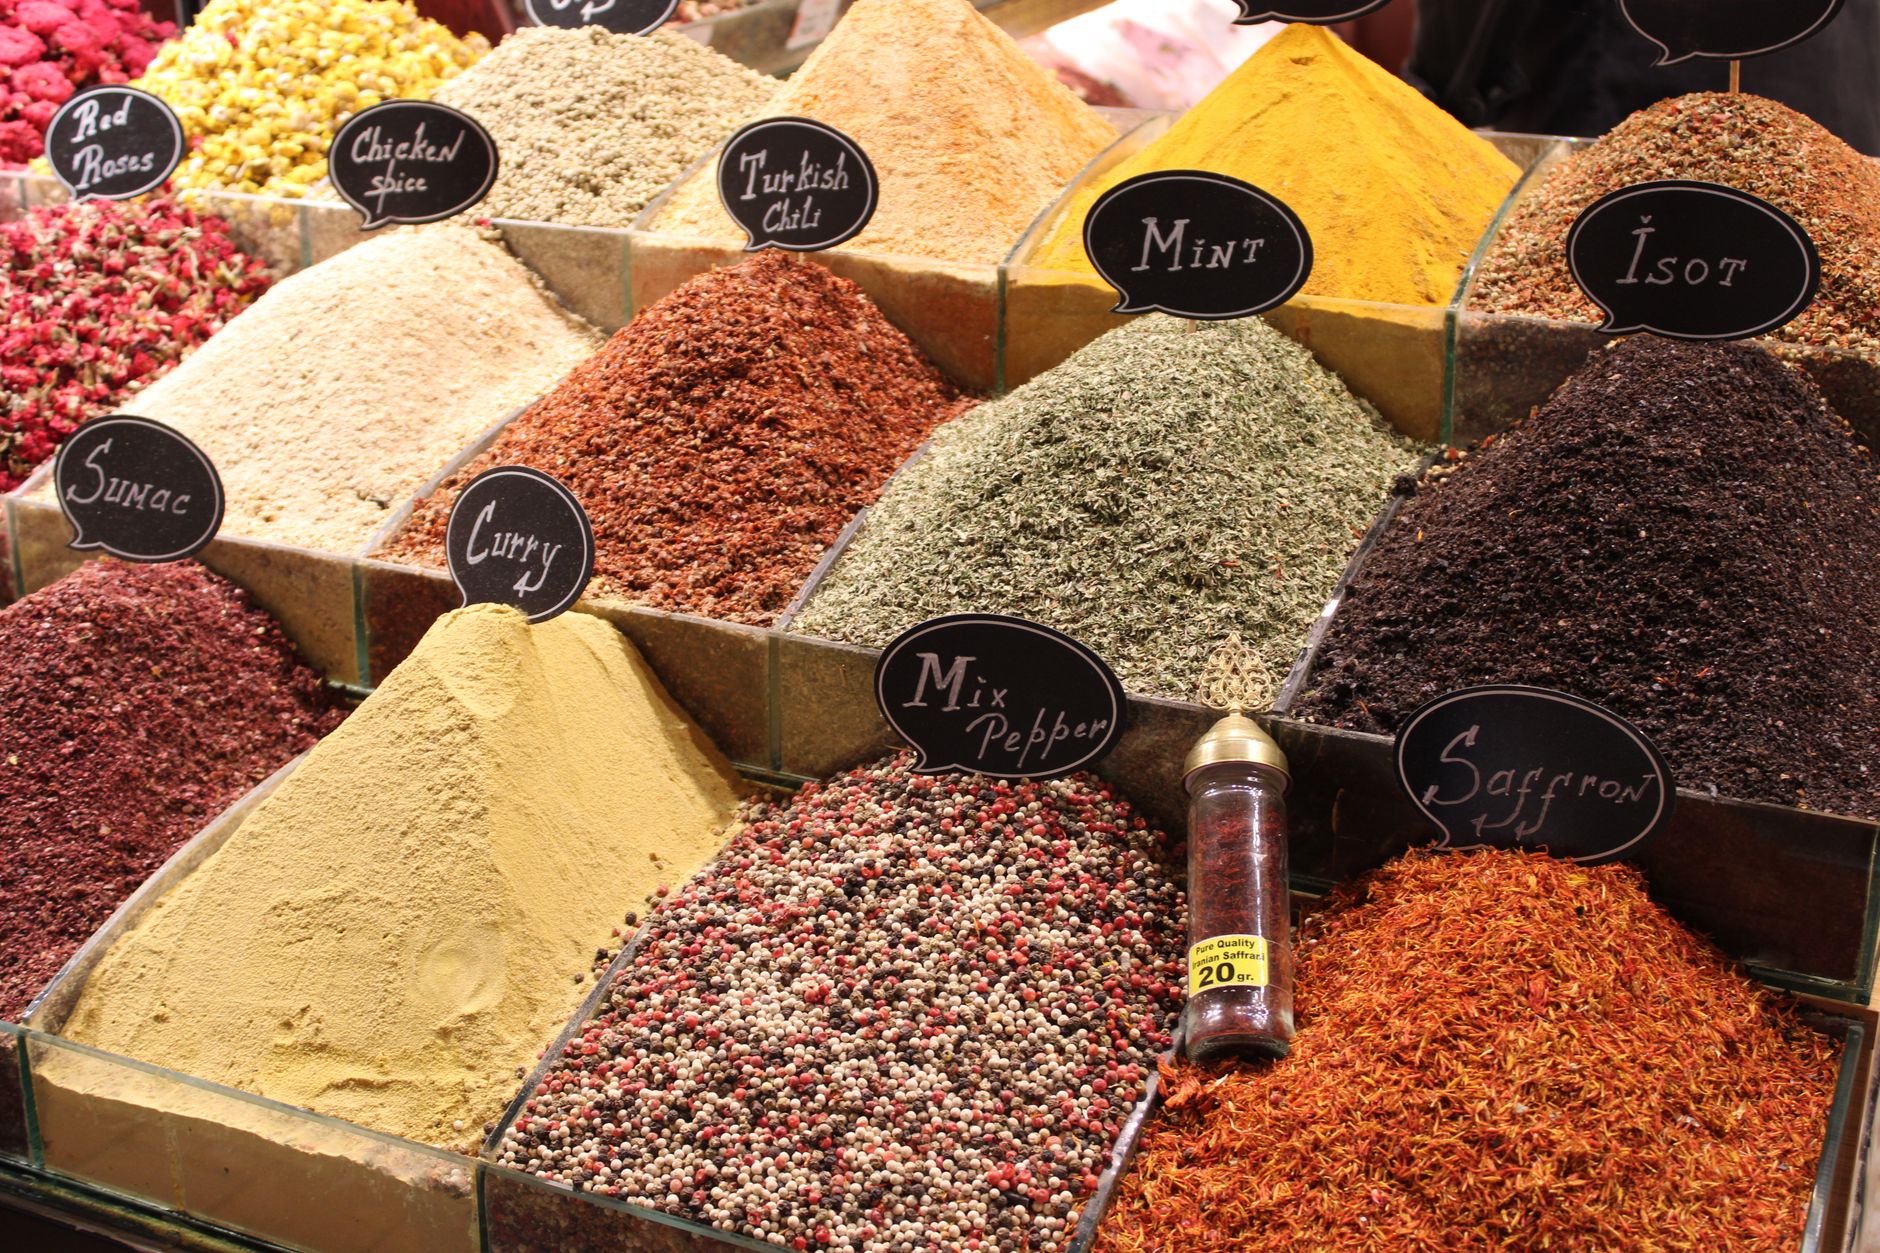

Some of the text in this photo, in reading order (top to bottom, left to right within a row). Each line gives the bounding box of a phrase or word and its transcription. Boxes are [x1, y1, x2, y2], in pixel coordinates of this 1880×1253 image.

[70, 95, 133, 143] Red
[72, 144, 155, 190] Roses
[740, 149, 849, 200] Turkish
[466, 500, 562, 598] Curry
[902, 652, 1009, 712] Mix
[965, 708, 1108, 768] Pepper
[1196, 938, 1255, 955] Pure Quality
[1198, 962, 1254, 988] 20 gr.
